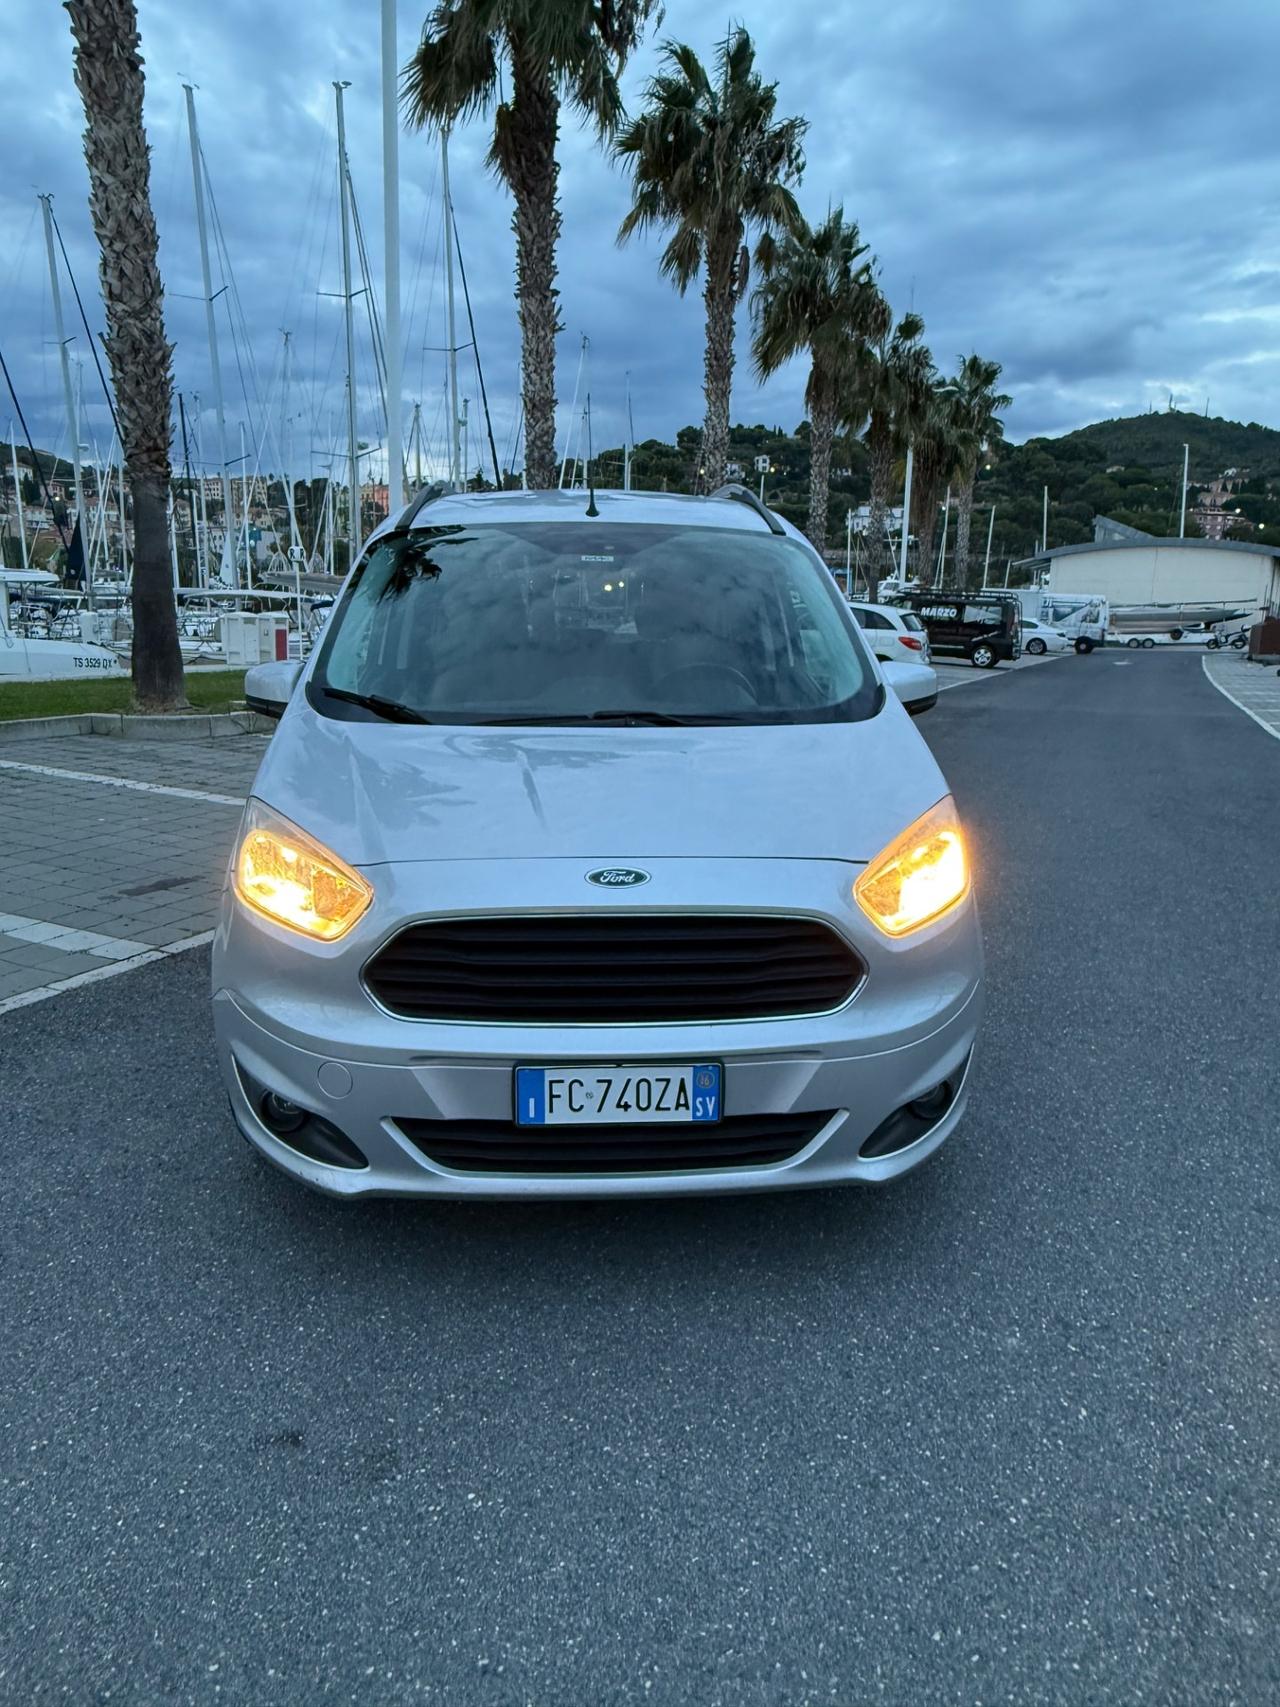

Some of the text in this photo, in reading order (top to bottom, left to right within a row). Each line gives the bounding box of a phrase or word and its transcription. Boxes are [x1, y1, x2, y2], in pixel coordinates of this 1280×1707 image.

[920, 606, 957, 618] MARZO
[73, 657, 84, 668] TS
[600, 870, 635, 883] Ford
[695, 1096, 716, 1117] SV
